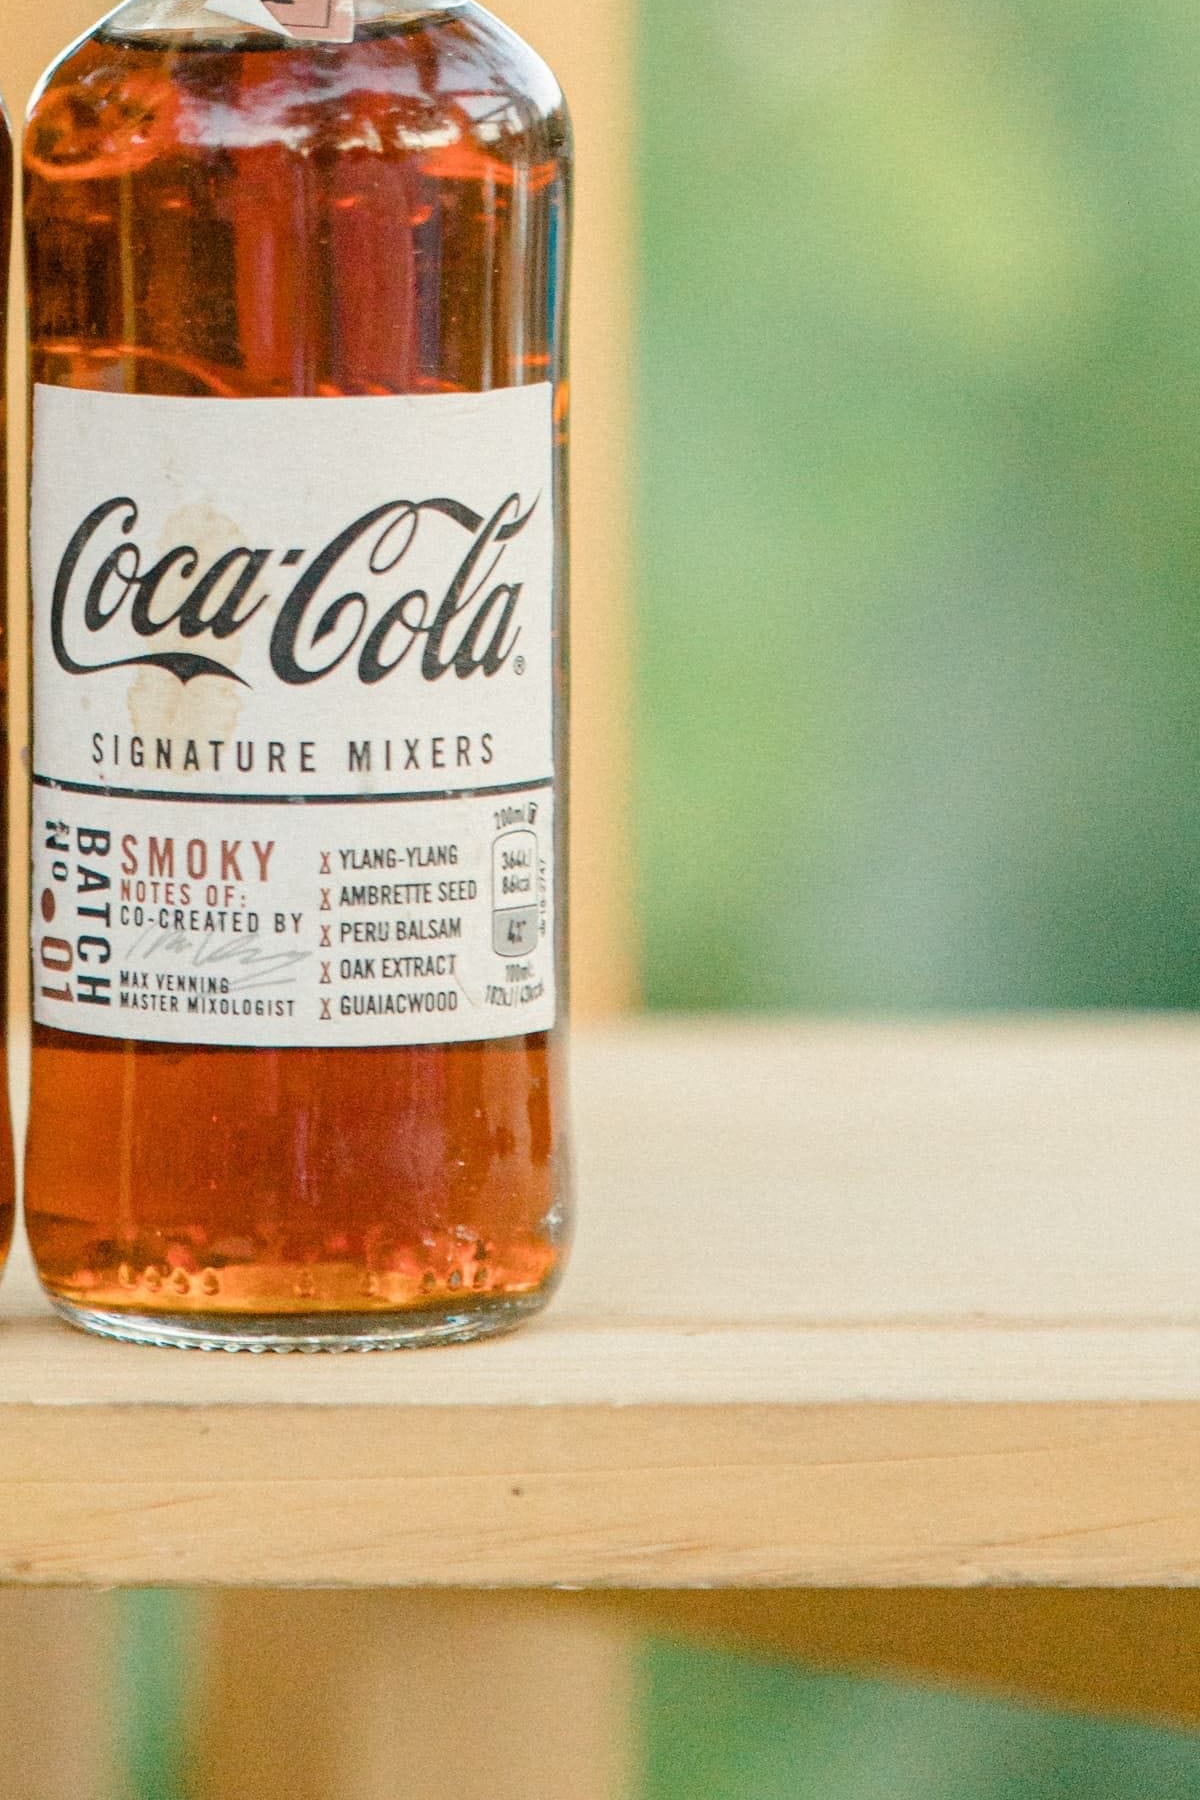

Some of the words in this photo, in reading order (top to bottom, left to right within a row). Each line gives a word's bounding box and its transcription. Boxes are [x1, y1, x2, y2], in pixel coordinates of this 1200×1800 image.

[91, 732, 316, 773] SIGNATURE
[348, 731, 495, 773] MIXERS
[120, 834, 276, 882] SMOKY
[338, 844, 458, 871] YLANG-YLANG
[120, 879, 191, 906] NOTES
[206, 884, 247, 908] OF:
[338, 882, 433, 907] AMBRETTE
[438, 879, 478, 903] SEED
[76, 826, 111, 1006] BATCH
[119, 905, 259, 933] CO-CREATED
[274, 912, 303, 933] BY
[339, 920, 390, 944] PERU
[395, 917, 462, 942] BALSAM
[339, 958, 376, 980] OAK
[381, 953, 457, 979] EXTRACT
[119, 969, 149, 990] MAX
[156, 973, 230, 994] VENNING
[119, 991, 180, 1013] MASTER
[187, 997, 296, 1017] MIXOLOGIST
[339, 990, 459, 1017] GUAIACWOOD
